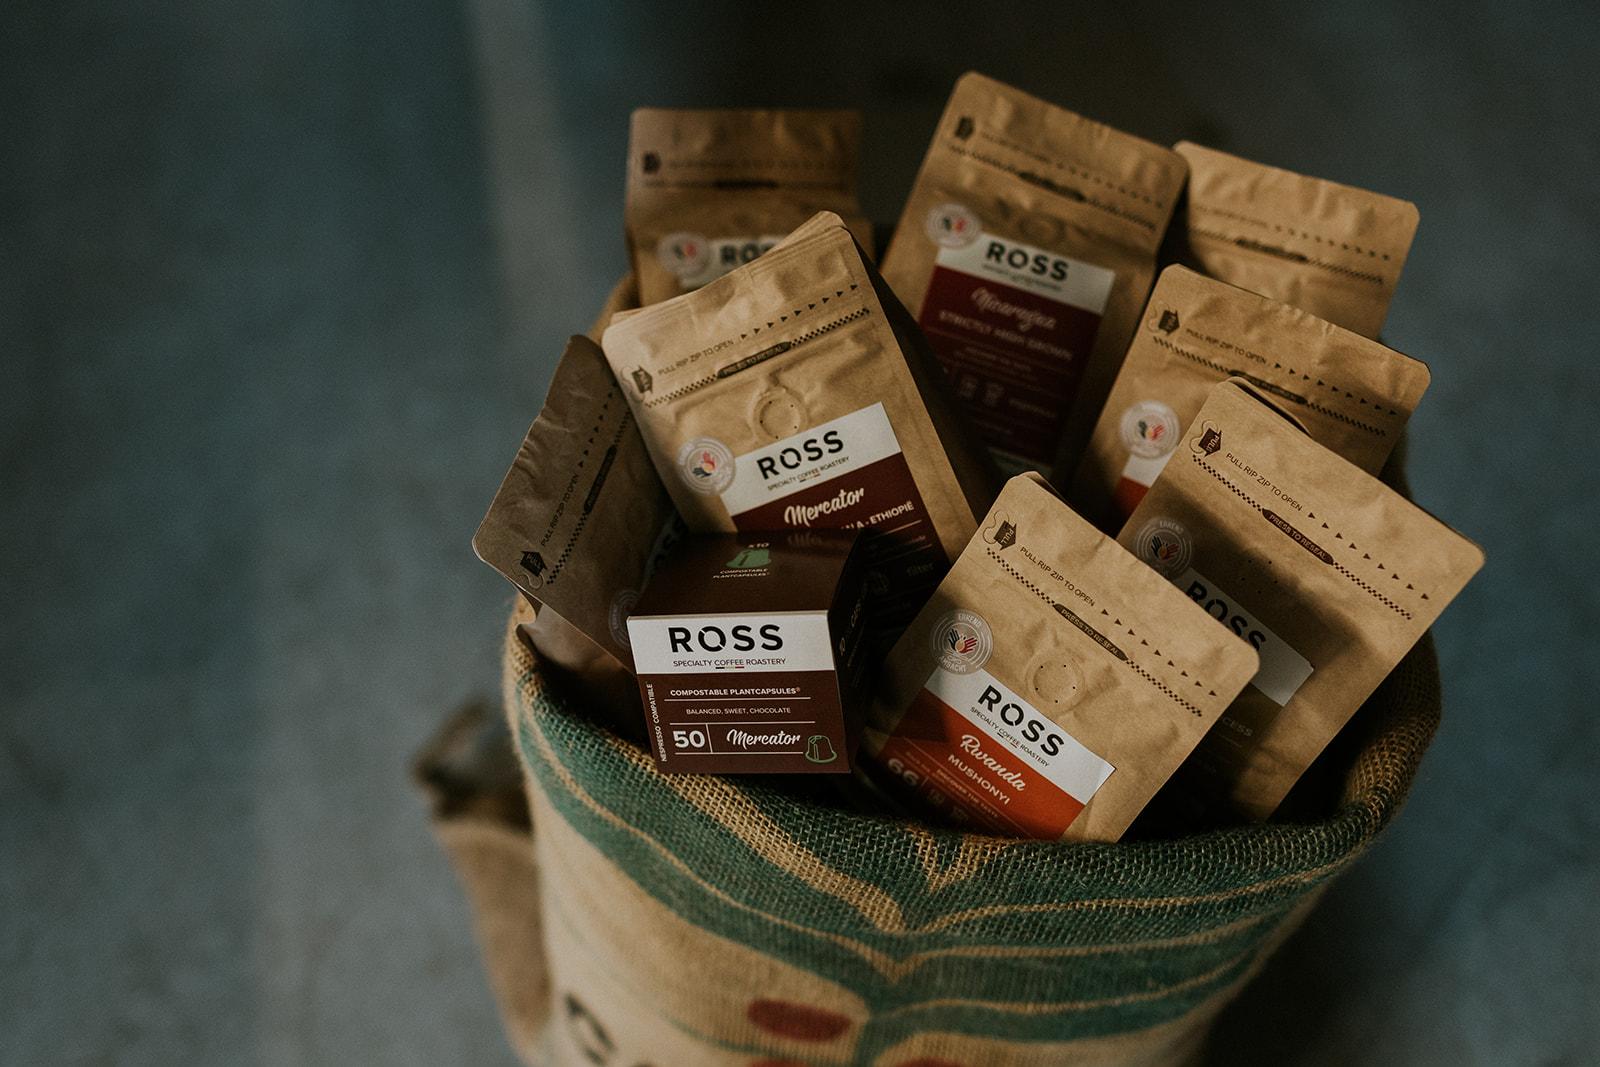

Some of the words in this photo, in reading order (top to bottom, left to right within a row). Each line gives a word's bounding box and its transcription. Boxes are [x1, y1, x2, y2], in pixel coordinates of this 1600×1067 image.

[986, 242, 1069, 281] ROSS
[657, 364, 675, 377] PULL
[703, 347, 714, 357] TO
[714, 339, 734, 352] OPEN
[1235, 346, 1245, 356] TO
[1245, 351, 1266, 364] OPEN
[757, 430, 843, 480] ROSS
[1206, 434, 1220, 452] PULL
[768, 476, 797, 491] SPECIALTY
[797, 467, 819, 481] COFFEE
[820, 456, 850, 471] ROASTERY
[1225, 452, 1243, 469] PULL
[1243, 466, 1258, 479] RIP
[1257, 476, 1271, 487] ZIP
[1271, 485, 1281, 496] TO
[1281, 494, 1303, 511] OPEN
[783, 487, 865, 528] Mercator
[1000, 527, 1015, 545] PULL
[1268, 514, 1291, 534] PRESS
[1290, 529, 1301, 541] TO
[1300, 538, 1330, 561] RESEAL
[1020, 546, 1037, 563] PULL
[1038, 560, 1051, 572] RIP
[1050, 571, 1064, 582] ZIP
[1064, 580, 1075, 591] TO
[1074, 589, 1095, 606] OPEN
[1186, 581, 1266, 651] ROSS
[668, 624, 784, 653] ROSS
[745, 658, 786, 666] ROASTERY
[646, 683, 660, 724] COMPATIBLE
[670, 688, 729, 697] COMPOSTABLE
[686, 708, 724, 716] BALANCED,
[749, 707, 792, 715] CHOCOLATE
[672, 730, 706, 749] 50
[726, 728, 801, 750] Mercator
[970, 706, 1000, 730] SPECIALTY
[998, 728, 1020, 746] COFFEE
[1020, 743, 1050, 767] ROASTERY
[978, 685, 1064, 756] ROSS
[654, 725, 668, 762] NESPRESSO
[948, 754, 1010, 805] MUSHONYI
[960, 734, 1026, 792] Rwanda
